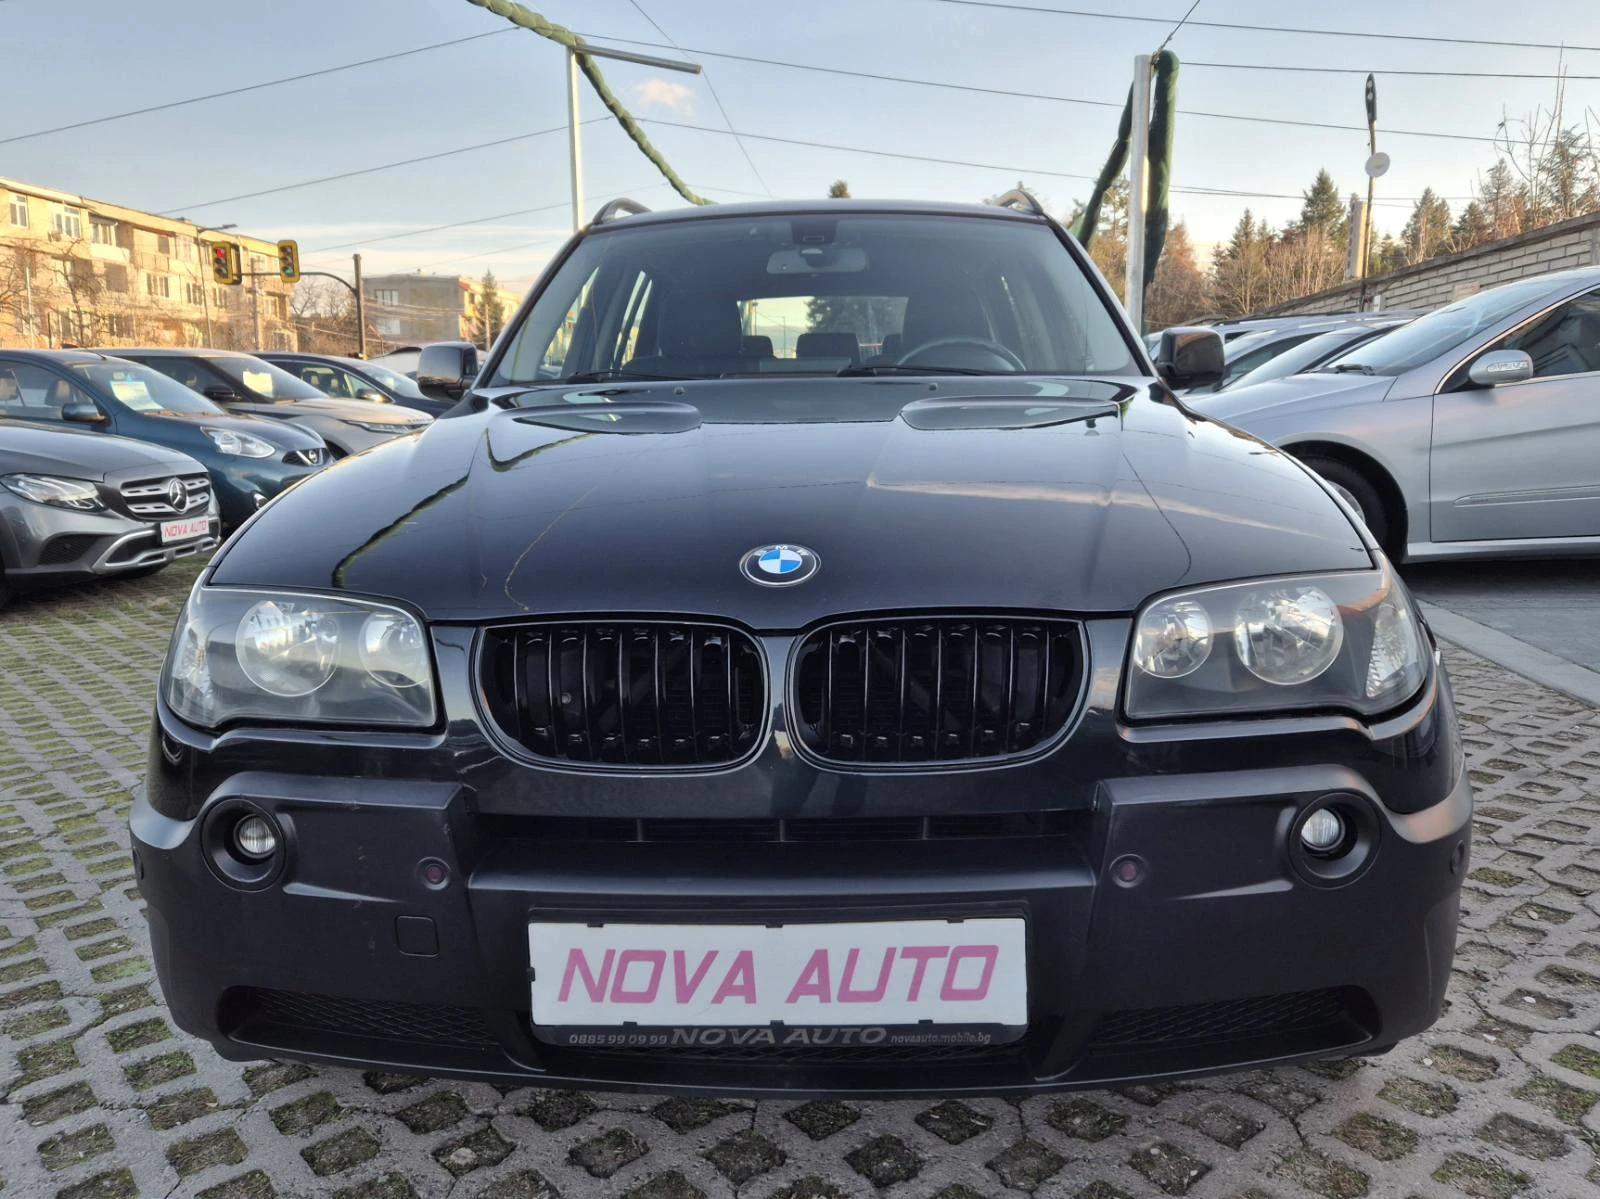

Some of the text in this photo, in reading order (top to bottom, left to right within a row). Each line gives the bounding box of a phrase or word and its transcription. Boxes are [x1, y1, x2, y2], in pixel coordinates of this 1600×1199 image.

[165, 525, 187, 538] NOVA
[557, 944, 999, 1004] NOVA AUTO
[568, 1034, 605, 1045] 0885
[607, 1034, 625, 1044] 99
[628, 1034, 647, 1044] 09
[649, 1034, 667, 1045] 99
[670, 1028, 776, 1045] NOVA
[783, 1027, 887, 1044] AUTO
